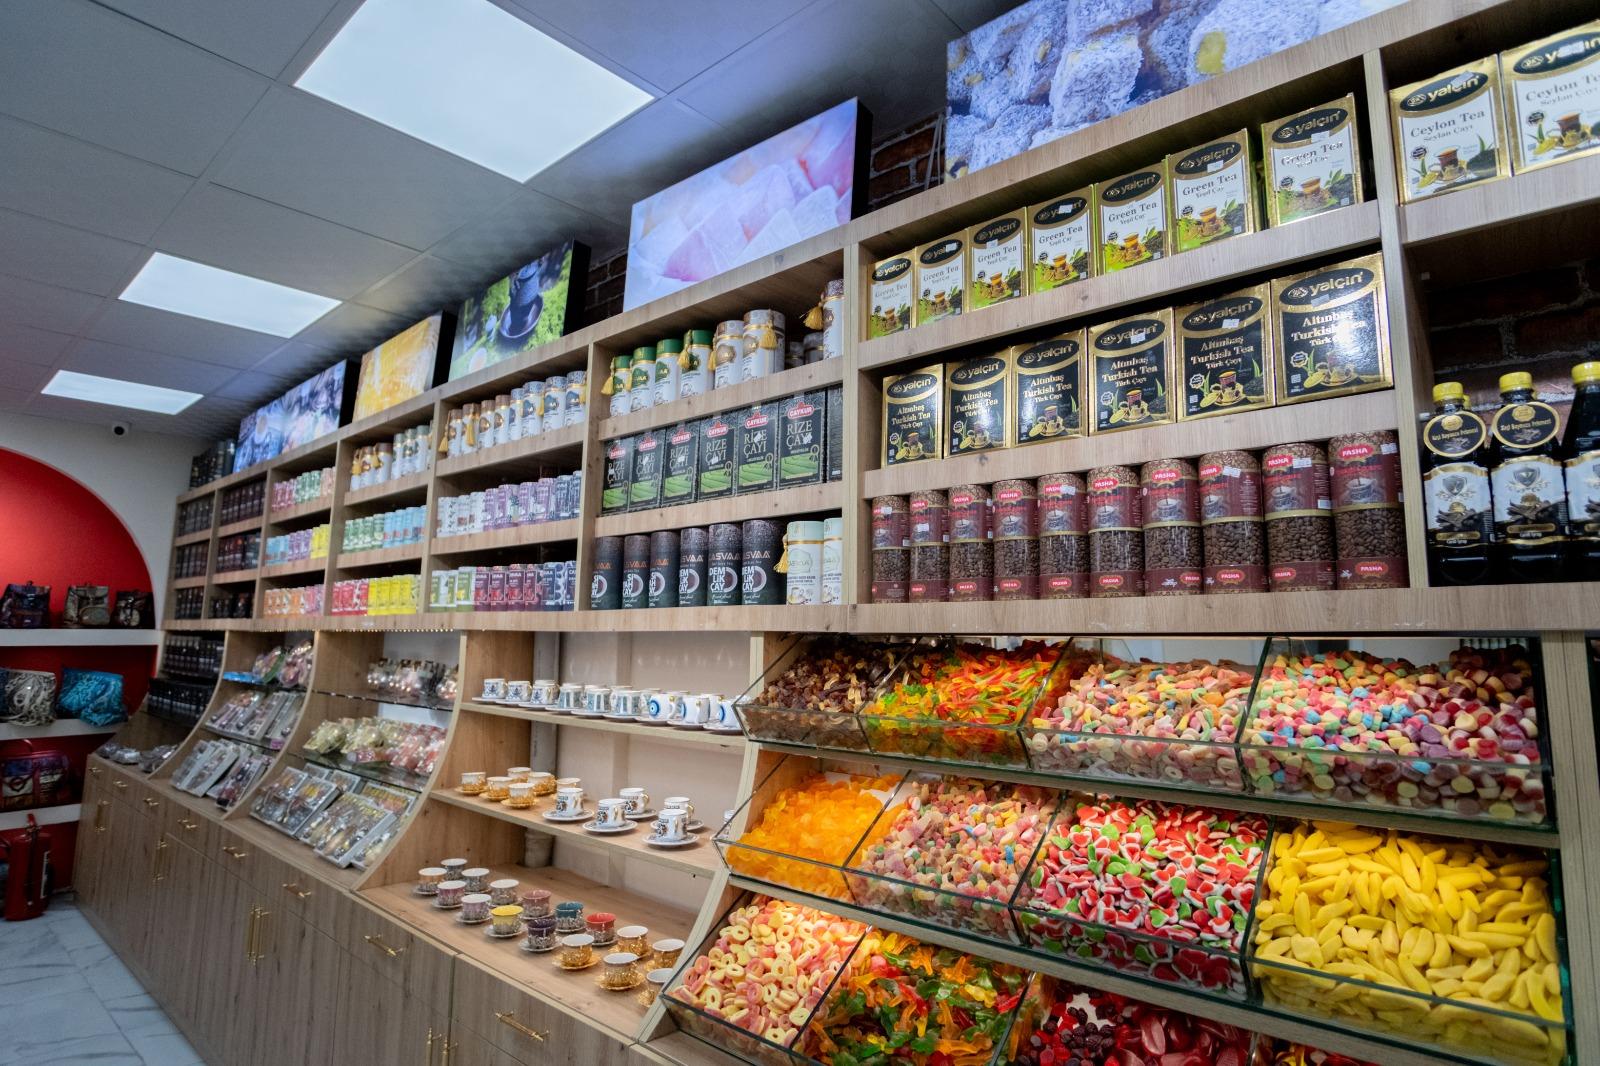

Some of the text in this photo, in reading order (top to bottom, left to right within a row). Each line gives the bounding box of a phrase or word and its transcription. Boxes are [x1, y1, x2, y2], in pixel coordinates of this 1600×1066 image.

[1526, 81, 1578, 101] Ceylon
[1411, 110, 1485, 138] Ceylon Tea
[1423, 129, 1453, 141] Seylan
[1281, 140, 1344, 166] Green Tea
[1182, 173, 1237, 196] Green Tea
[1108, 201, 1157, 223] Green Tea
[1038, 225, 1083, 244] Green Tea
[977, 245, 1017, 263] Green Tea
[923, 264, 960, 282] Green Tea
[1308, 272, 1363, 296] yalçın
[1191, 344, 1254, 365] Turkish Tea
[1102, 365, 1158, 383] Turkish Tea
[1023, 383, 1072, 399] Turkish Tea
[985, 398, 998, 406] Tea
[789, 407, 813, 417] ÇAYKUR
[891, 412, 931, 425] Turkish Tea
[746, 418, 768, 427] ÇAYKUR
[787, 420, 813, 436] RİZE
[706, 438, 727, 453] RİZE
[1342, 447, 1368, 456] PASHA
[1268, 458, 1289, 466] PASHA
[1094, 480, 1114, 488] PASHA
[1154, 472, 1176, 480] PASHA
[709, 566, 726, 577] DEM
